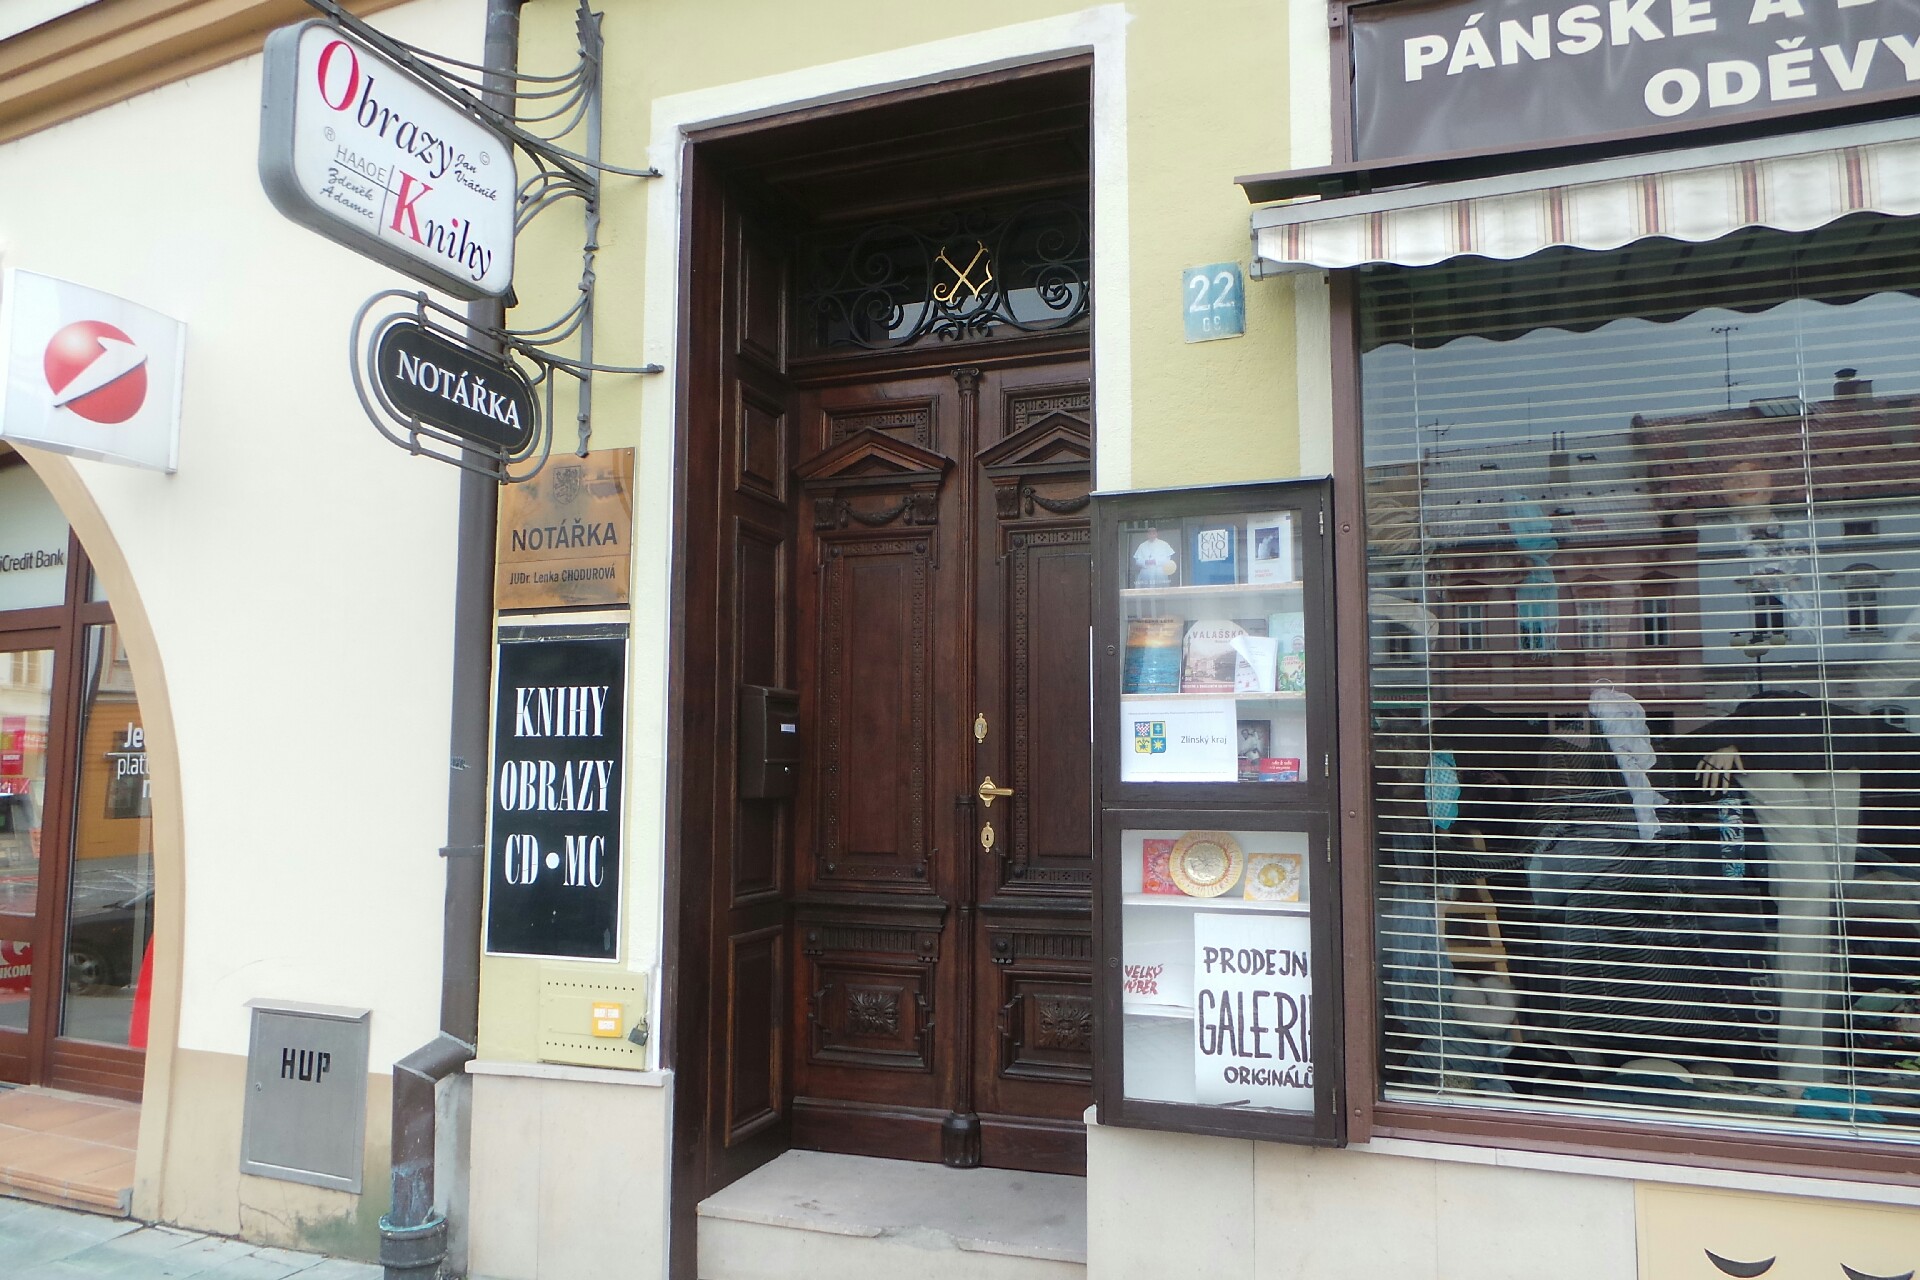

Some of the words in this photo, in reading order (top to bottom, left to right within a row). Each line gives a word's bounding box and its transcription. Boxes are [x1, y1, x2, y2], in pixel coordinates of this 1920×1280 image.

[1644, 35, 1920, 117] ODĚVY
[317, 40, 454, 179] Obrazy
[336, 144, 386, 183] HAAOE
[455, 153, 477, 173] Jan
[328, 167, 373, 200] Zdeněk
[319, 186, 374, 219] Adamec
[389, 169, 491, 281] Knihy
[1189, 271, 1235, 313] 22
[396, 349, 521, 430] NOTÁŘKA
[511, 518, 618, 552] NOTÁŘKA
[1201, 531, 1226, 542] KAN
[35, 548, 64, 568] Bank
[1201, 549, 1226, 559] NAL
[510, 572, 530, 585] JUDr.
[534, 571, 559, 583] Lenka
[561, 564, 616, 582] CHODUROVÁ
[514, 686, 609, 737] KNIHY
[1211, 735, 1227, 746] kraj
[500, 760, 614, 812] OBRAZY
[505, 834, 539, 885] CD
[563, 834, 606, 888] MC
[1124, 963, 1164, 979] VELKÝ
[1203, 946, 1308, 978] PRODEJN
[281, 1047, 331, 1083] HUP
